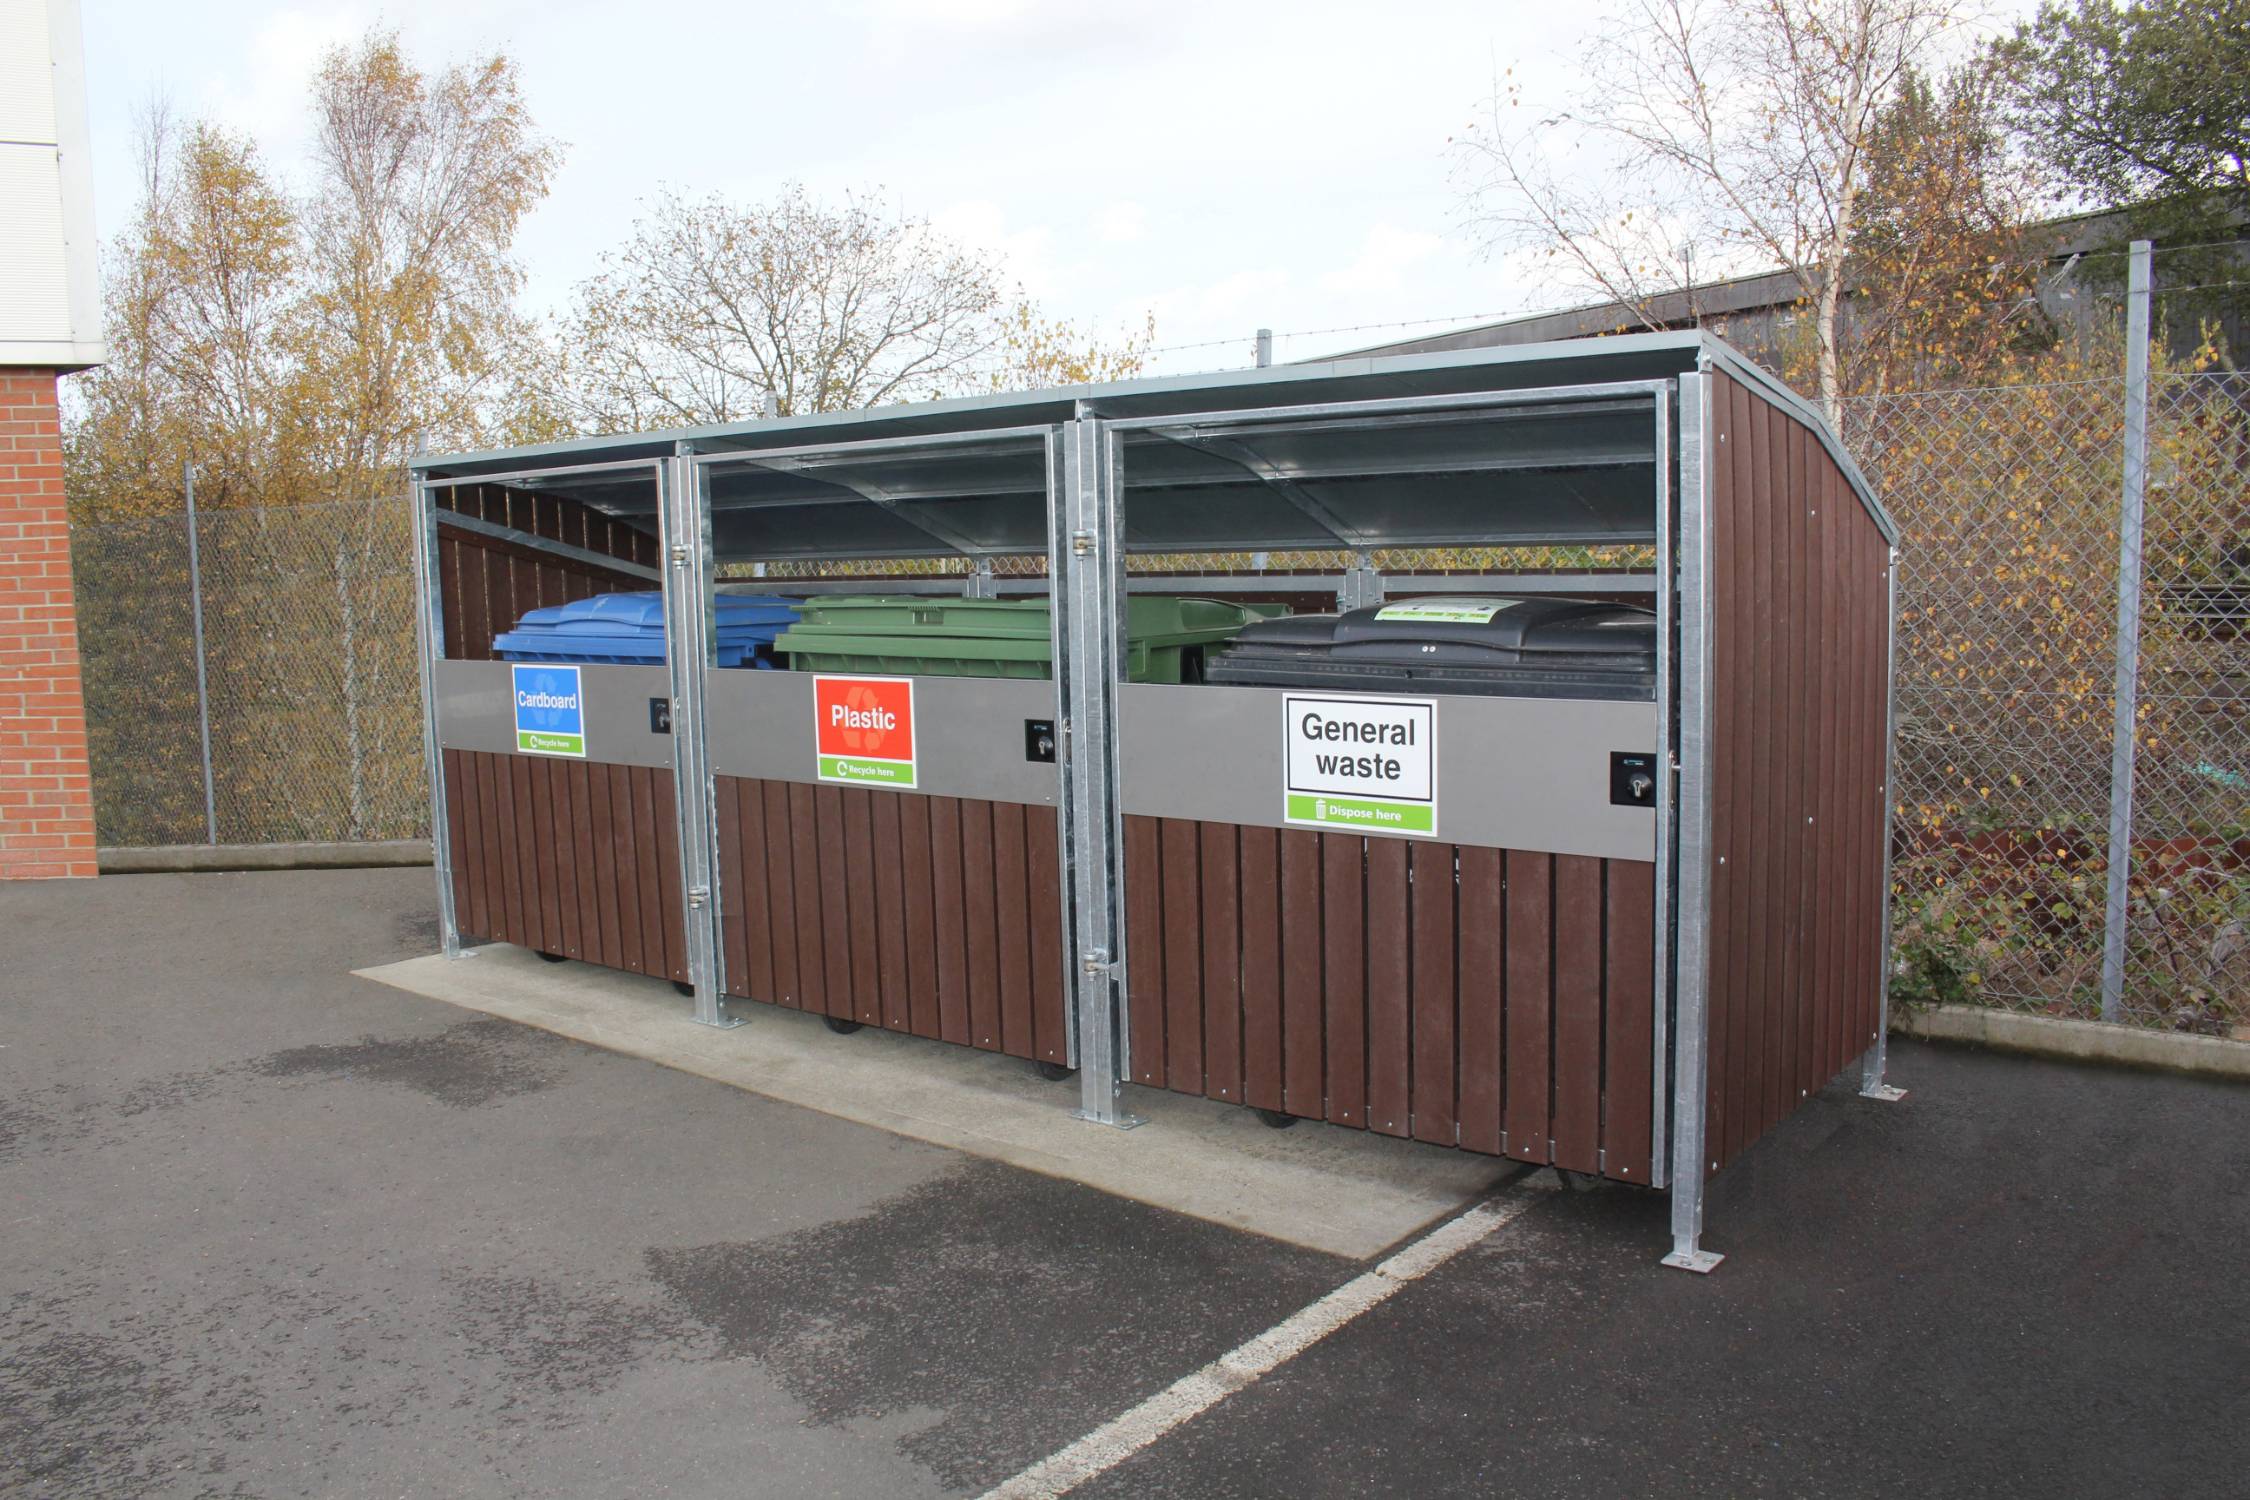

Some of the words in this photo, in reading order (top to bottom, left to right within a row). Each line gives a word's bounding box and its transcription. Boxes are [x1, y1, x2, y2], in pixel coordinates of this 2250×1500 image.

[518, 691, 576, 709] Cardboard
[831, 704, 896, 730] Plastic
[1302, 712, 1415, 746] General
[848, 764, 876, 776] Recycle
[877, 767, 895, 776] here
[1315, 753, 1401, 780] waste
[1329, 805, 1373, 819] Dispose
[1376, 808, 1402, 821] here
